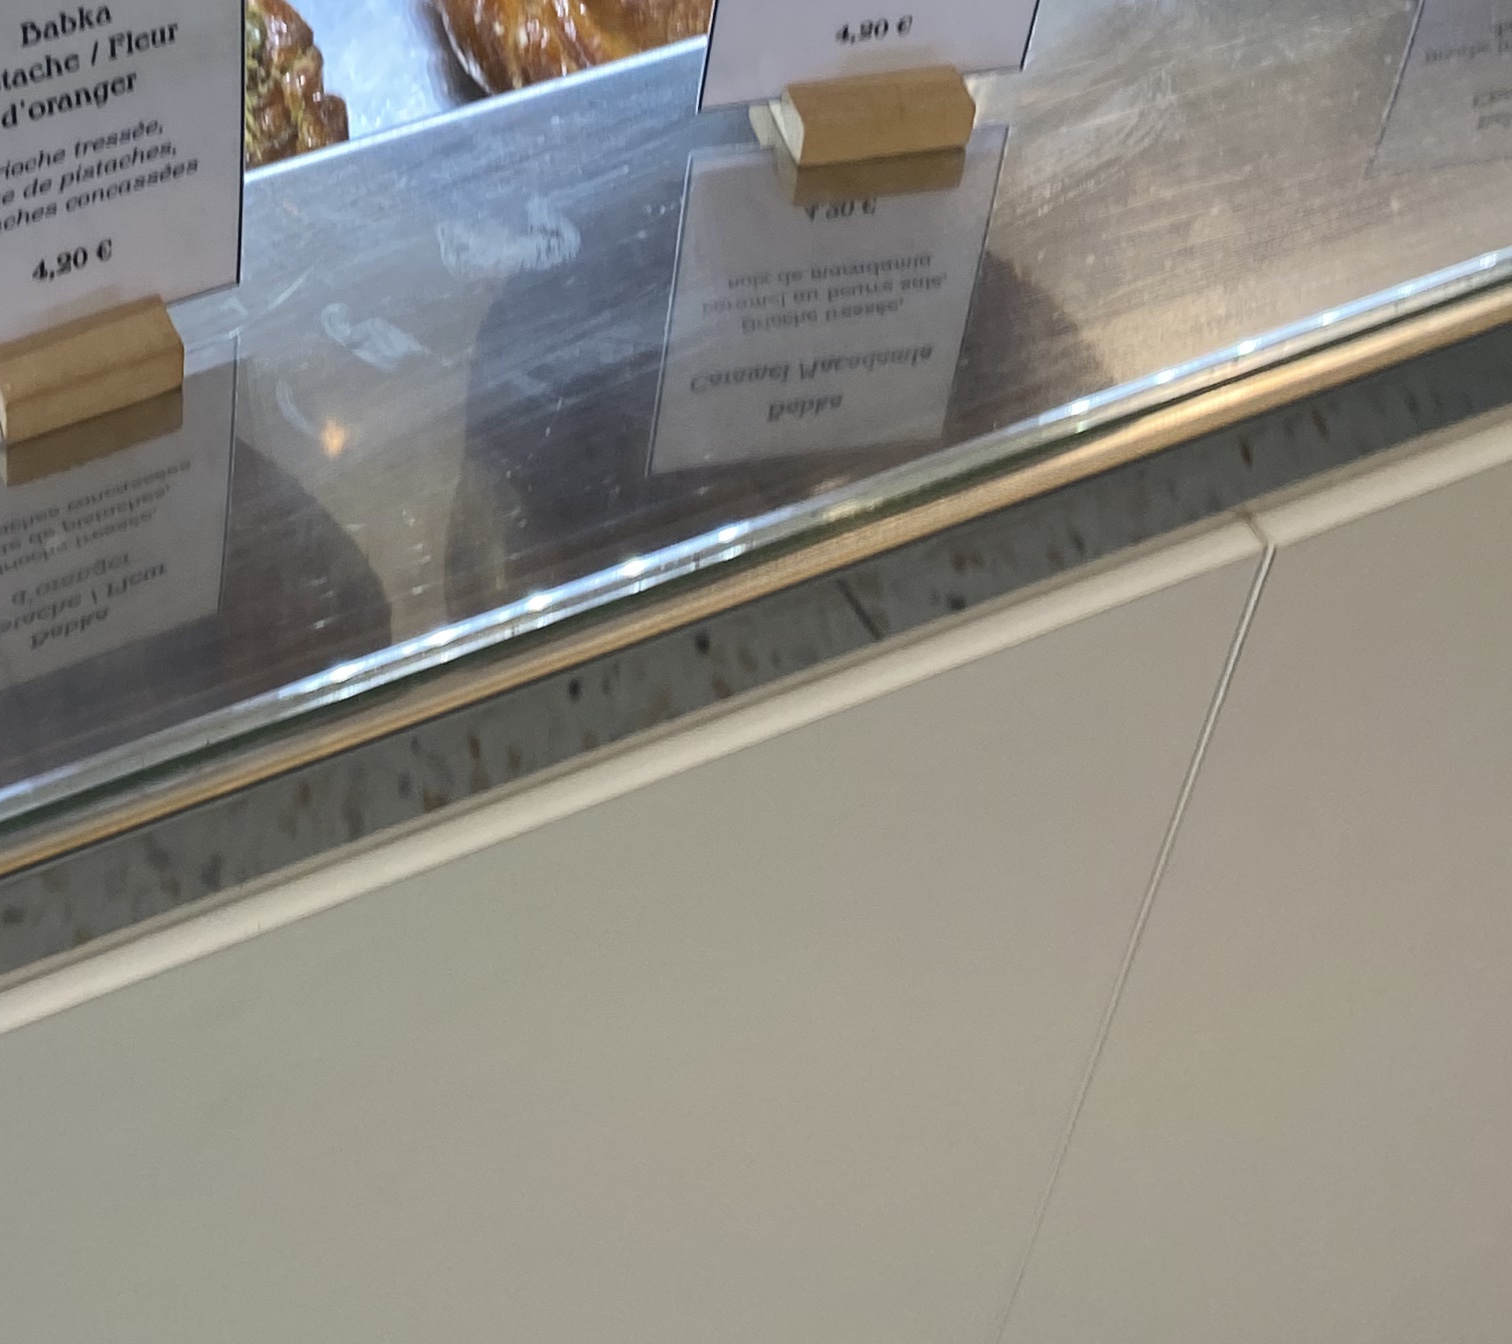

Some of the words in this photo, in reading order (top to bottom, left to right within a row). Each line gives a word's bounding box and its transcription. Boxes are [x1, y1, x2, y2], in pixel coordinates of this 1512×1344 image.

[20, 6, 111, 46] Babka
[90, 40, 98, 66] /
[109, 23, 177, 59] Fleur
[1, 72, 136, 127] d'oranger
[22, 177, 52, 198] de
[58, 141, 176, 193] pistaches,
[65, 158, 198, 211] concassées
[32, 247, 87, 280] 4,20
[96, 239, 111, 260] €
